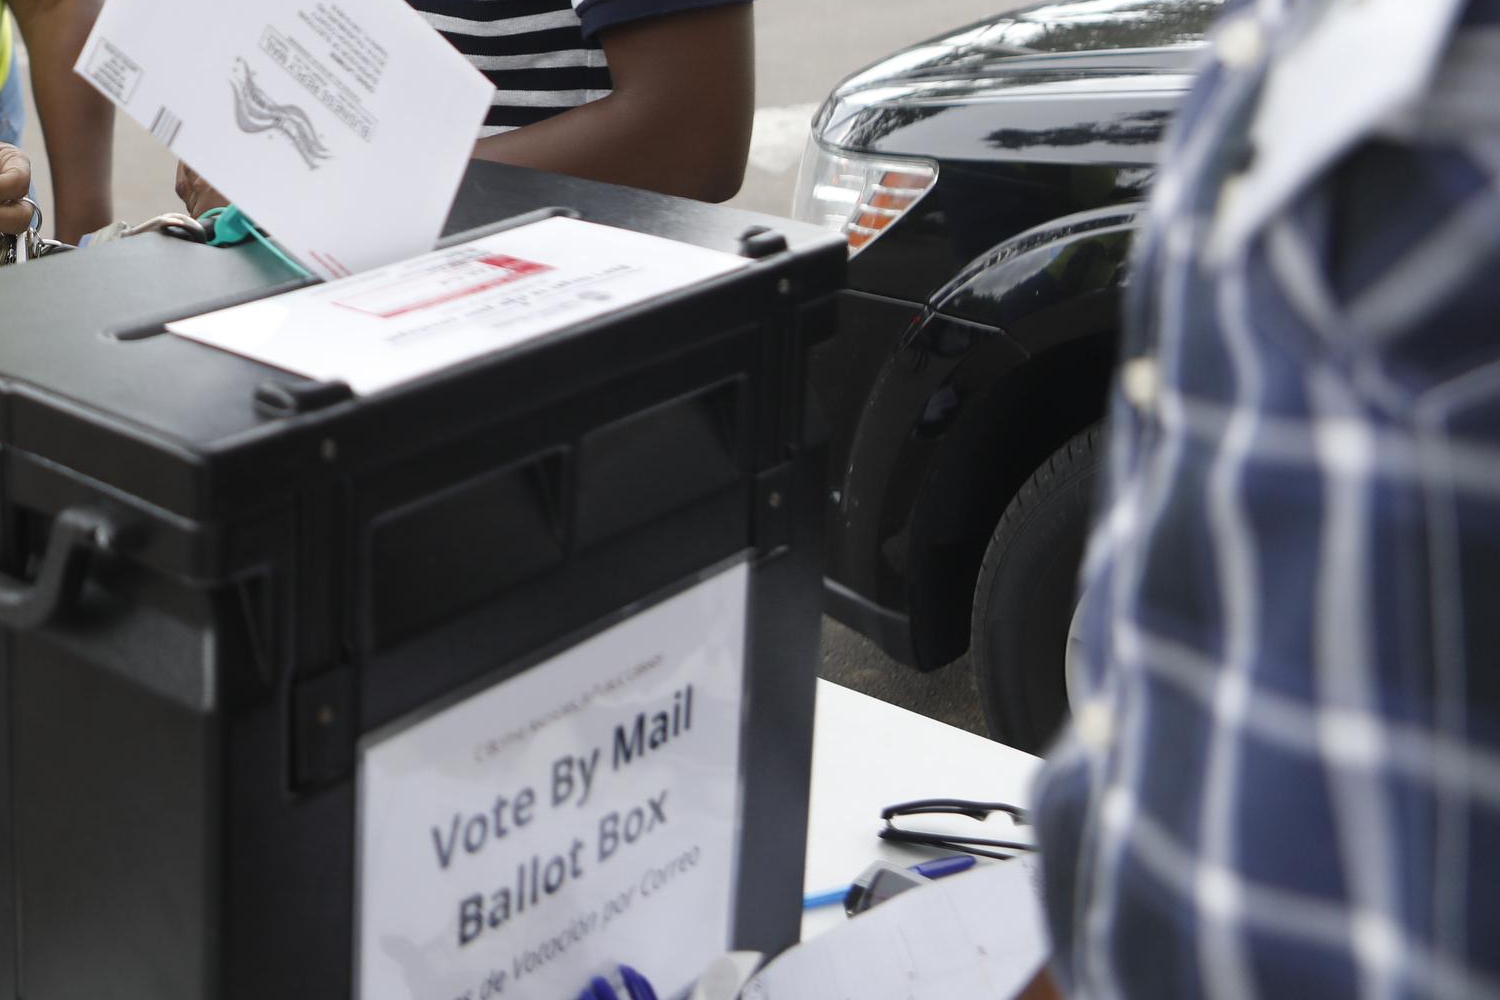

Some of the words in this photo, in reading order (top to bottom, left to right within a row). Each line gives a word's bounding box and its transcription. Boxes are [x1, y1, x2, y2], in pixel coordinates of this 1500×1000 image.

[430, 787, 536, 870] Vote
[551, 748, 600, 808] By
[611, 683, 694, 771] Mail
[458, 838, 586, 948] Ballot
[597, 790, 669, 863] Box
